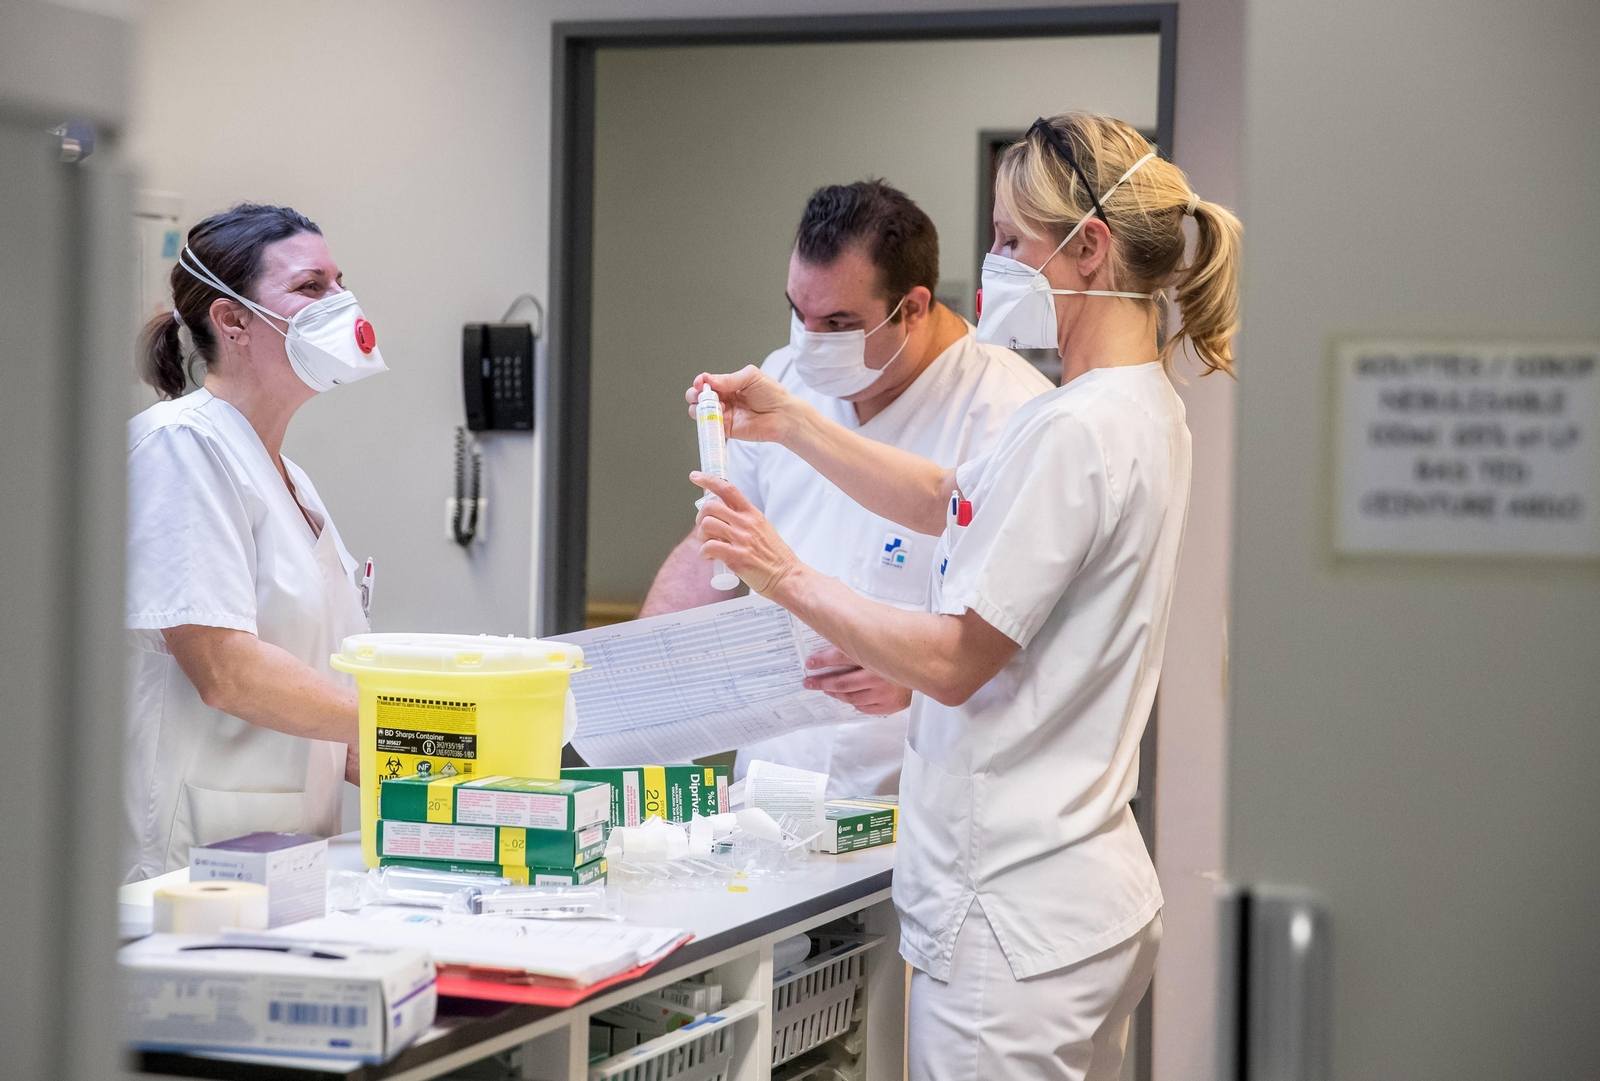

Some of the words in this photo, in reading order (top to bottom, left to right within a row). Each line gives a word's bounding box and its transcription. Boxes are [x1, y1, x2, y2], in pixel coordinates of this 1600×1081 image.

[396, 731, 415, 739] Sharps
[416, 732, 444, 741] Container
[689, 774, 701, 814] Dipriva
[707, 791, 715, 805] 2%
[428, 801, 440, 811] 20
[646, 790, 659, 812] 20
[512, 840, 524, 849] 20
